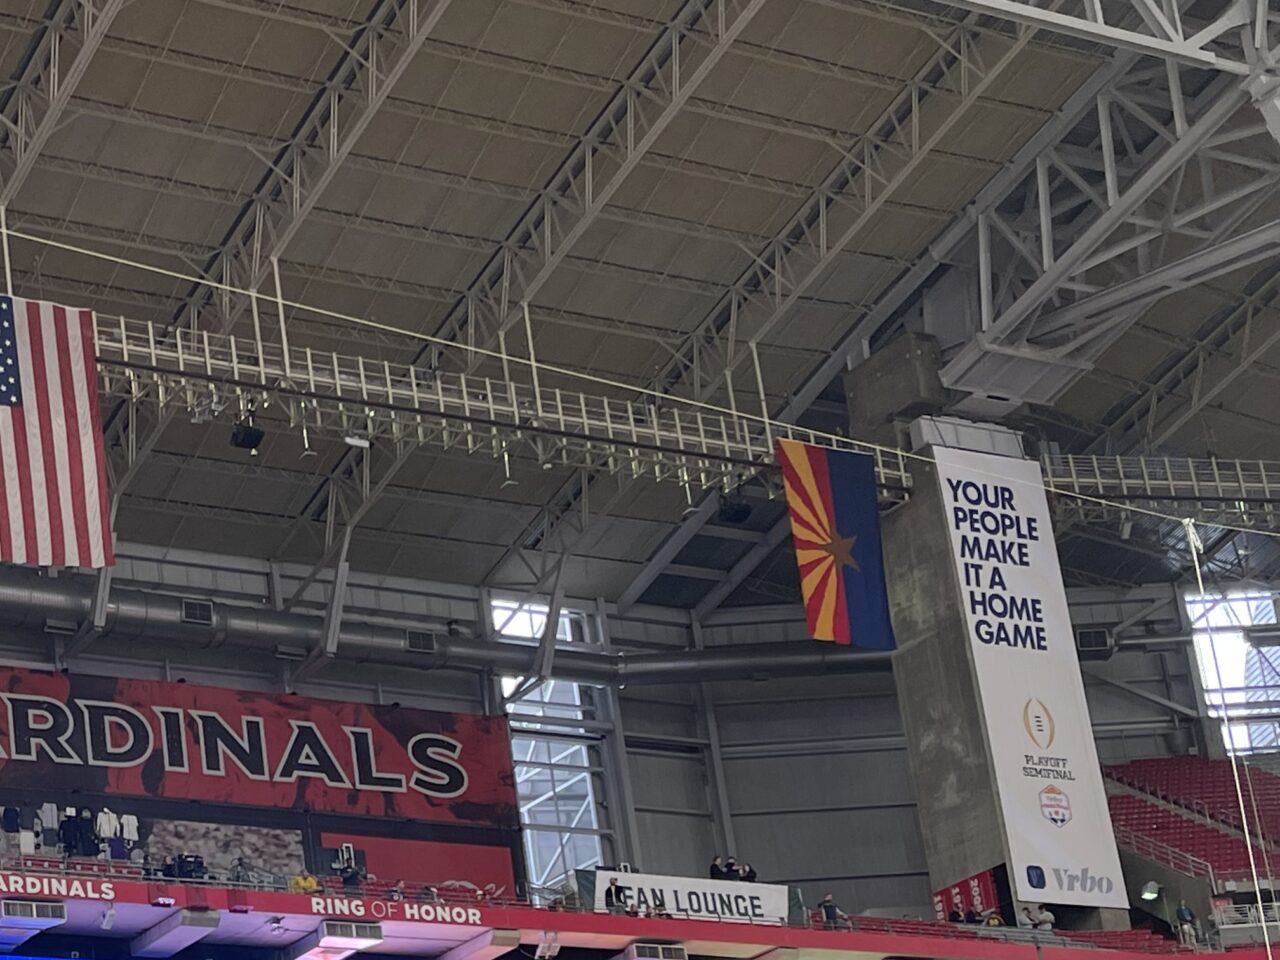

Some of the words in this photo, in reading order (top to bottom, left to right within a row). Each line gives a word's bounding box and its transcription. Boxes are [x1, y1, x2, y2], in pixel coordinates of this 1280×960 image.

[947, 478, 1016, 511] YOUR
[953, 507, 1039, 541] PEOPLE
[960, 535, 1030, 567] MAKE
[964, 563, 983, 587] IT
[988, 567, 1008, 592] A
[969, 591, 1043, 623] HOME
[975, 620, 1048, 651] GAME
[1022, 766, 1076, 781] SEMIFINAL
[1024, 754, 1068, 768] PLAYOFF
[1052, 867, 1113, 894] Vrbo
[311, 897, 365, 918] RING
[370, 901, 399, 919] OF
[404, 902, 483, 925] HONOR
[673, 890, 765, 918] LOUNGE
